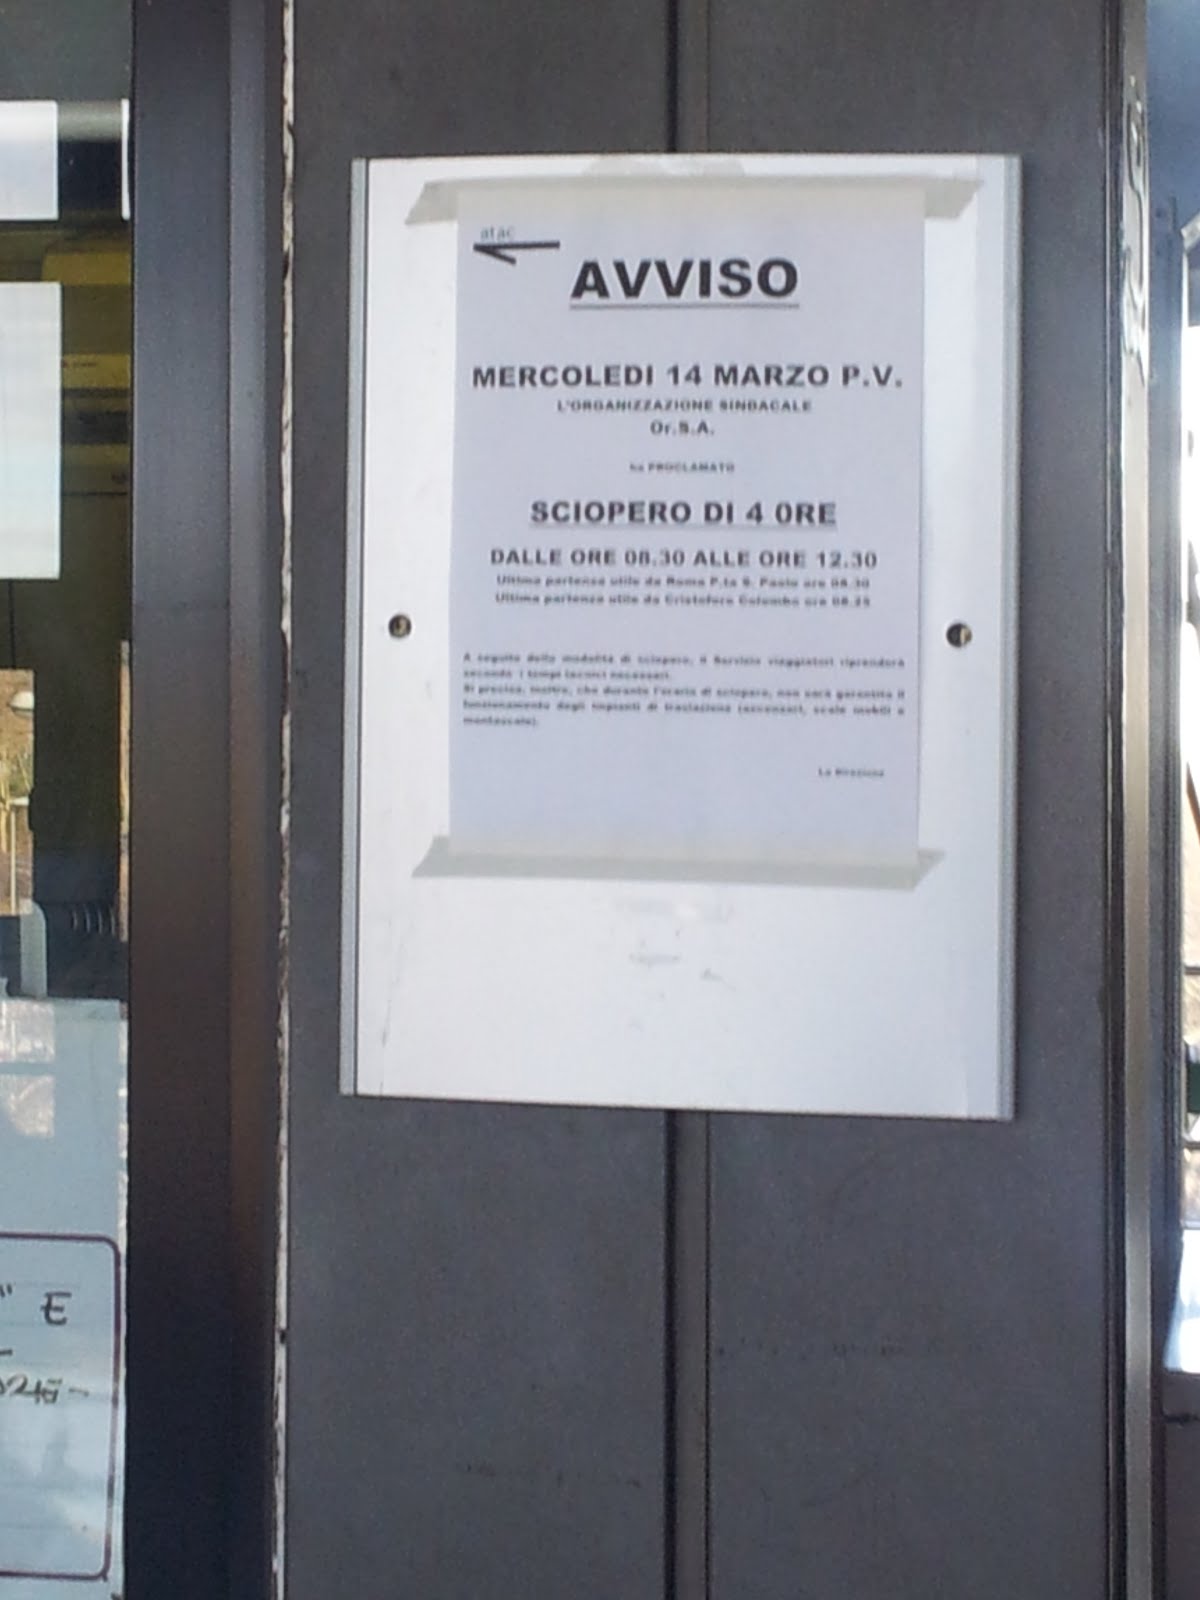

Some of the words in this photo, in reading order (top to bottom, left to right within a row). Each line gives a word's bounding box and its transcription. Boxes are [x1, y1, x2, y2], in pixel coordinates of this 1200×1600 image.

[571, 257, 798, 299] AVVISO
[472, 364, 653, 388] MERCOLEDI
[667, 364, 702, 387] 14
[714, 364, 829, 387] MARZO
[842, 365, 903, 388] P.V.
[557, 399, 713, 413] L'ORGANIZZAZIONE
[719, 399, 812, 414] SINDACALE
[648, 462, 735, 474] PROCLAMATO
[530, 500, 691, 524] SCIOPERO
[704, 501, 733, 525] DI
[746, 502, 763, 525] 4
[491, 549, 561, 566] DALLE
[570, 549, 616, 567] ORE
[625, 549, 685, 567] 08.30
[693, 550, 749, 568] ALLE
[759, 550, 806, 568] ORE
[817, 551, 877, 569] 12.30
